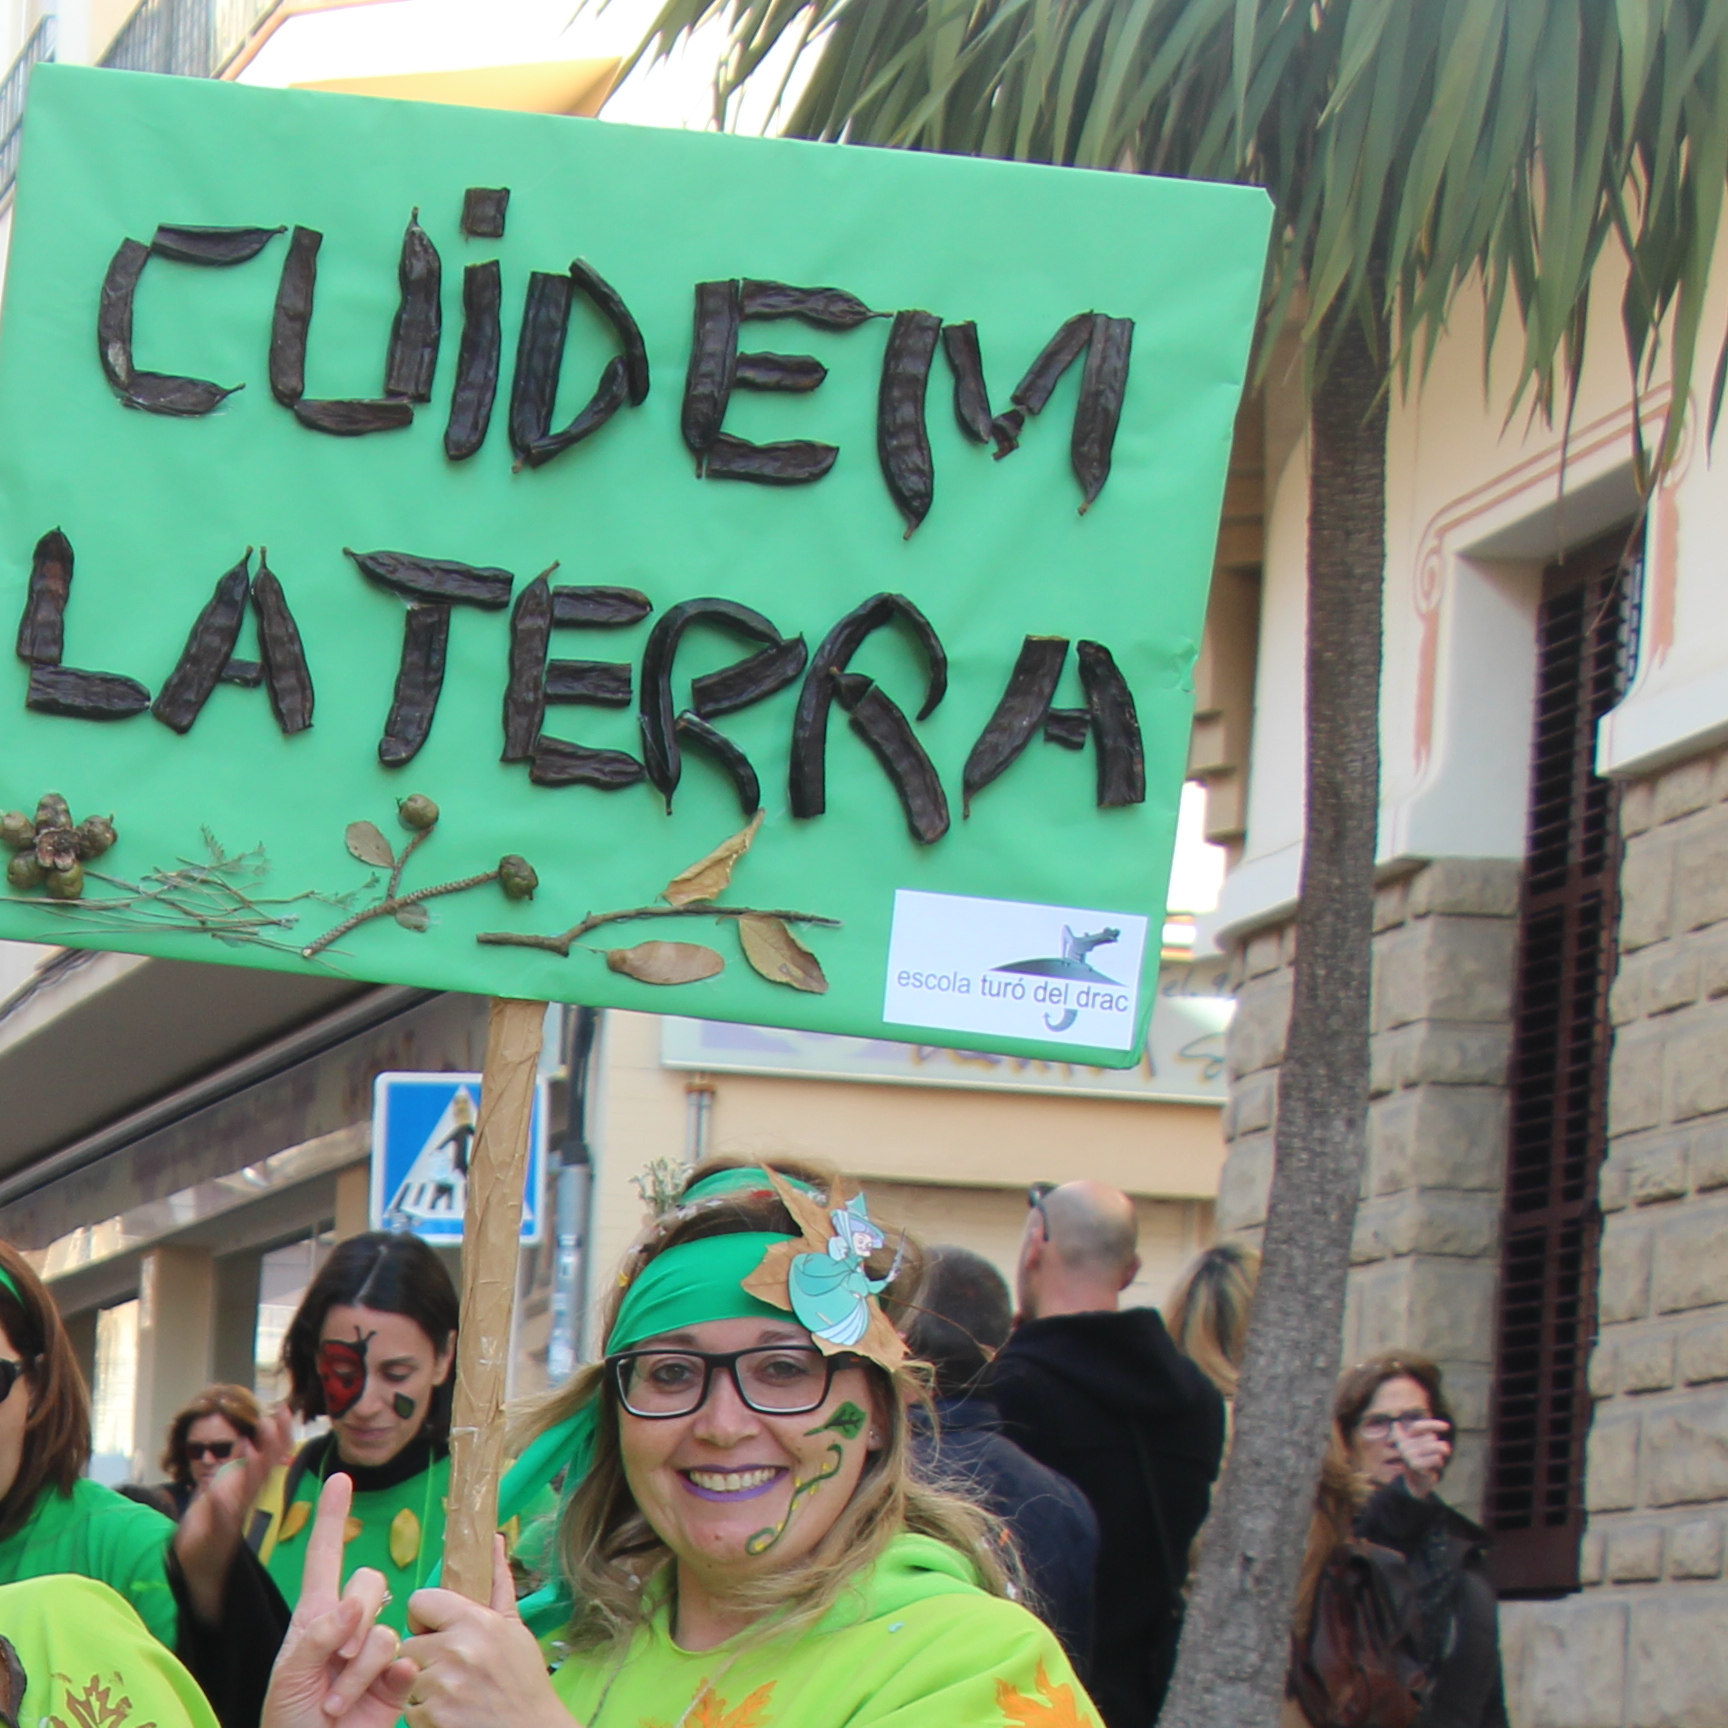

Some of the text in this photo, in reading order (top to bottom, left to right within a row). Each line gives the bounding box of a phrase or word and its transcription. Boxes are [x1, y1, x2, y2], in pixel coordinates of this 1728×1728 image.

[15, 527, 1145, 845] LA TERRA
[897, 970, 1129, 1013] escola turó del drac
